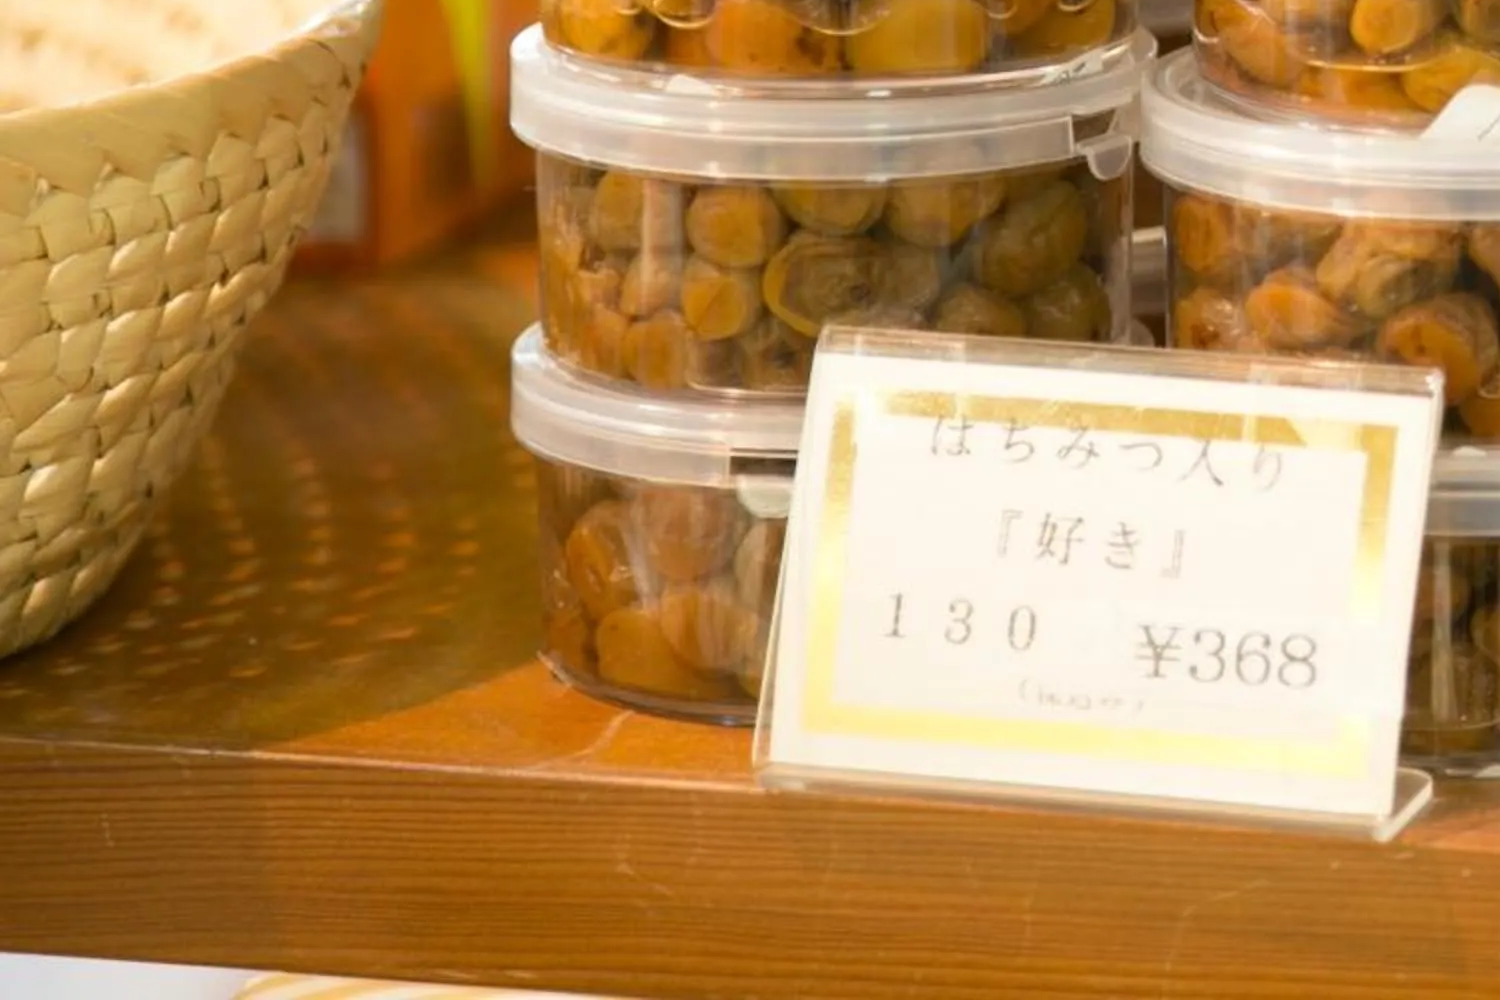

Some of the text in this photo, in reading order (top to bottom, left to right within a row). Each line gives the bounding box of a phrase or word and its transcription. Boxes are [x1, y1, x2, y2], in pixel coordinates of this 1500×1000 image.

[931, 414, 1284, 492] はちみつ入り
[882, 592, 1319, 689] 130 ¥368
